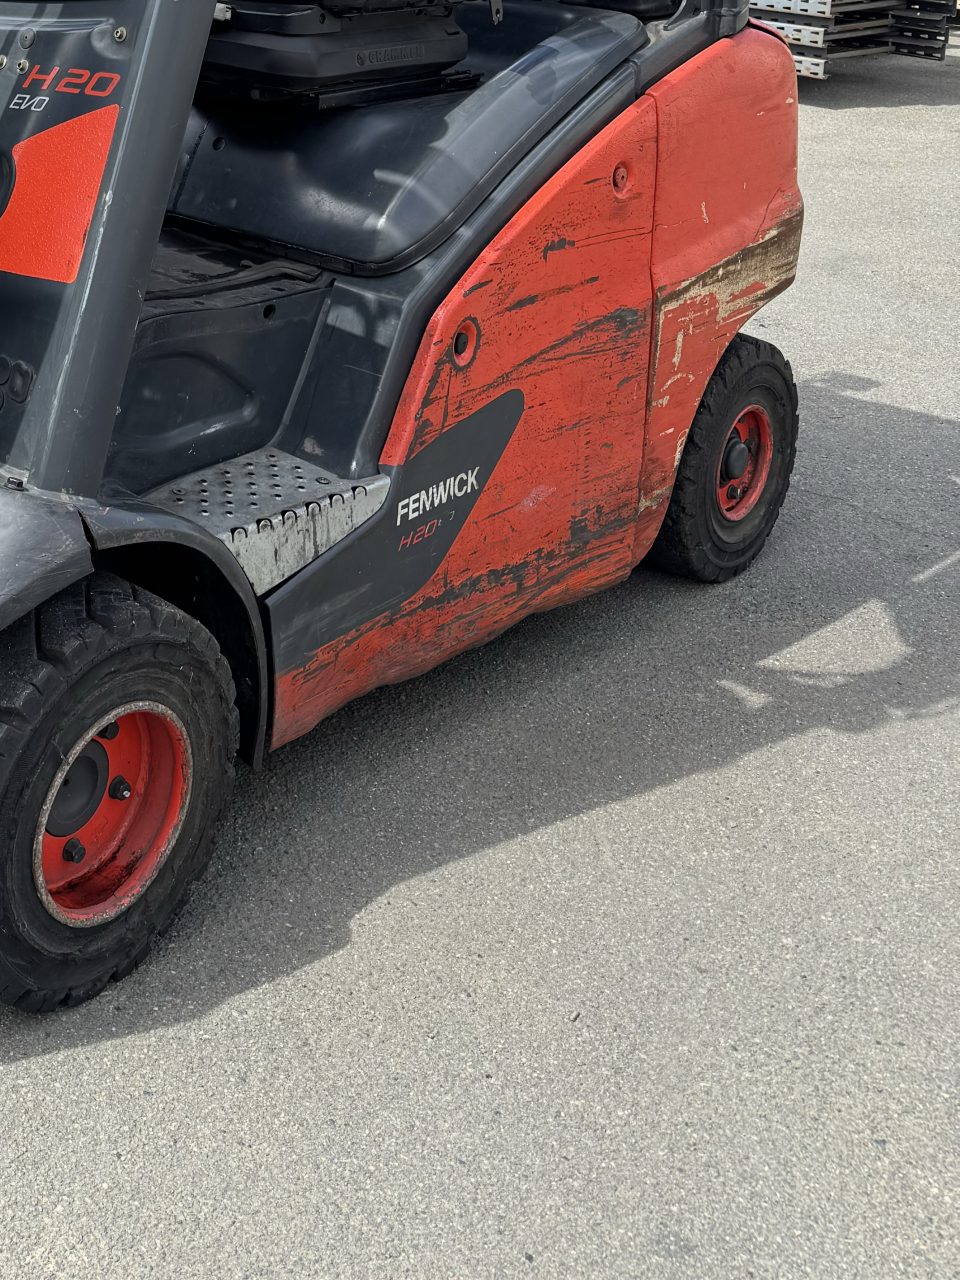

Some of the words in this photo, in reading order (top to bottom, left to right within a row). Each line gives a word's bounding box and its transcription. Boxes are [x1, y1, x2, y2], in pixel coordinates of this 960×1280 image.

[22, 64, 120, 97] H20
[9, 94, 49, 111] EVO
[396, 466, 480, 526] FENWICK
